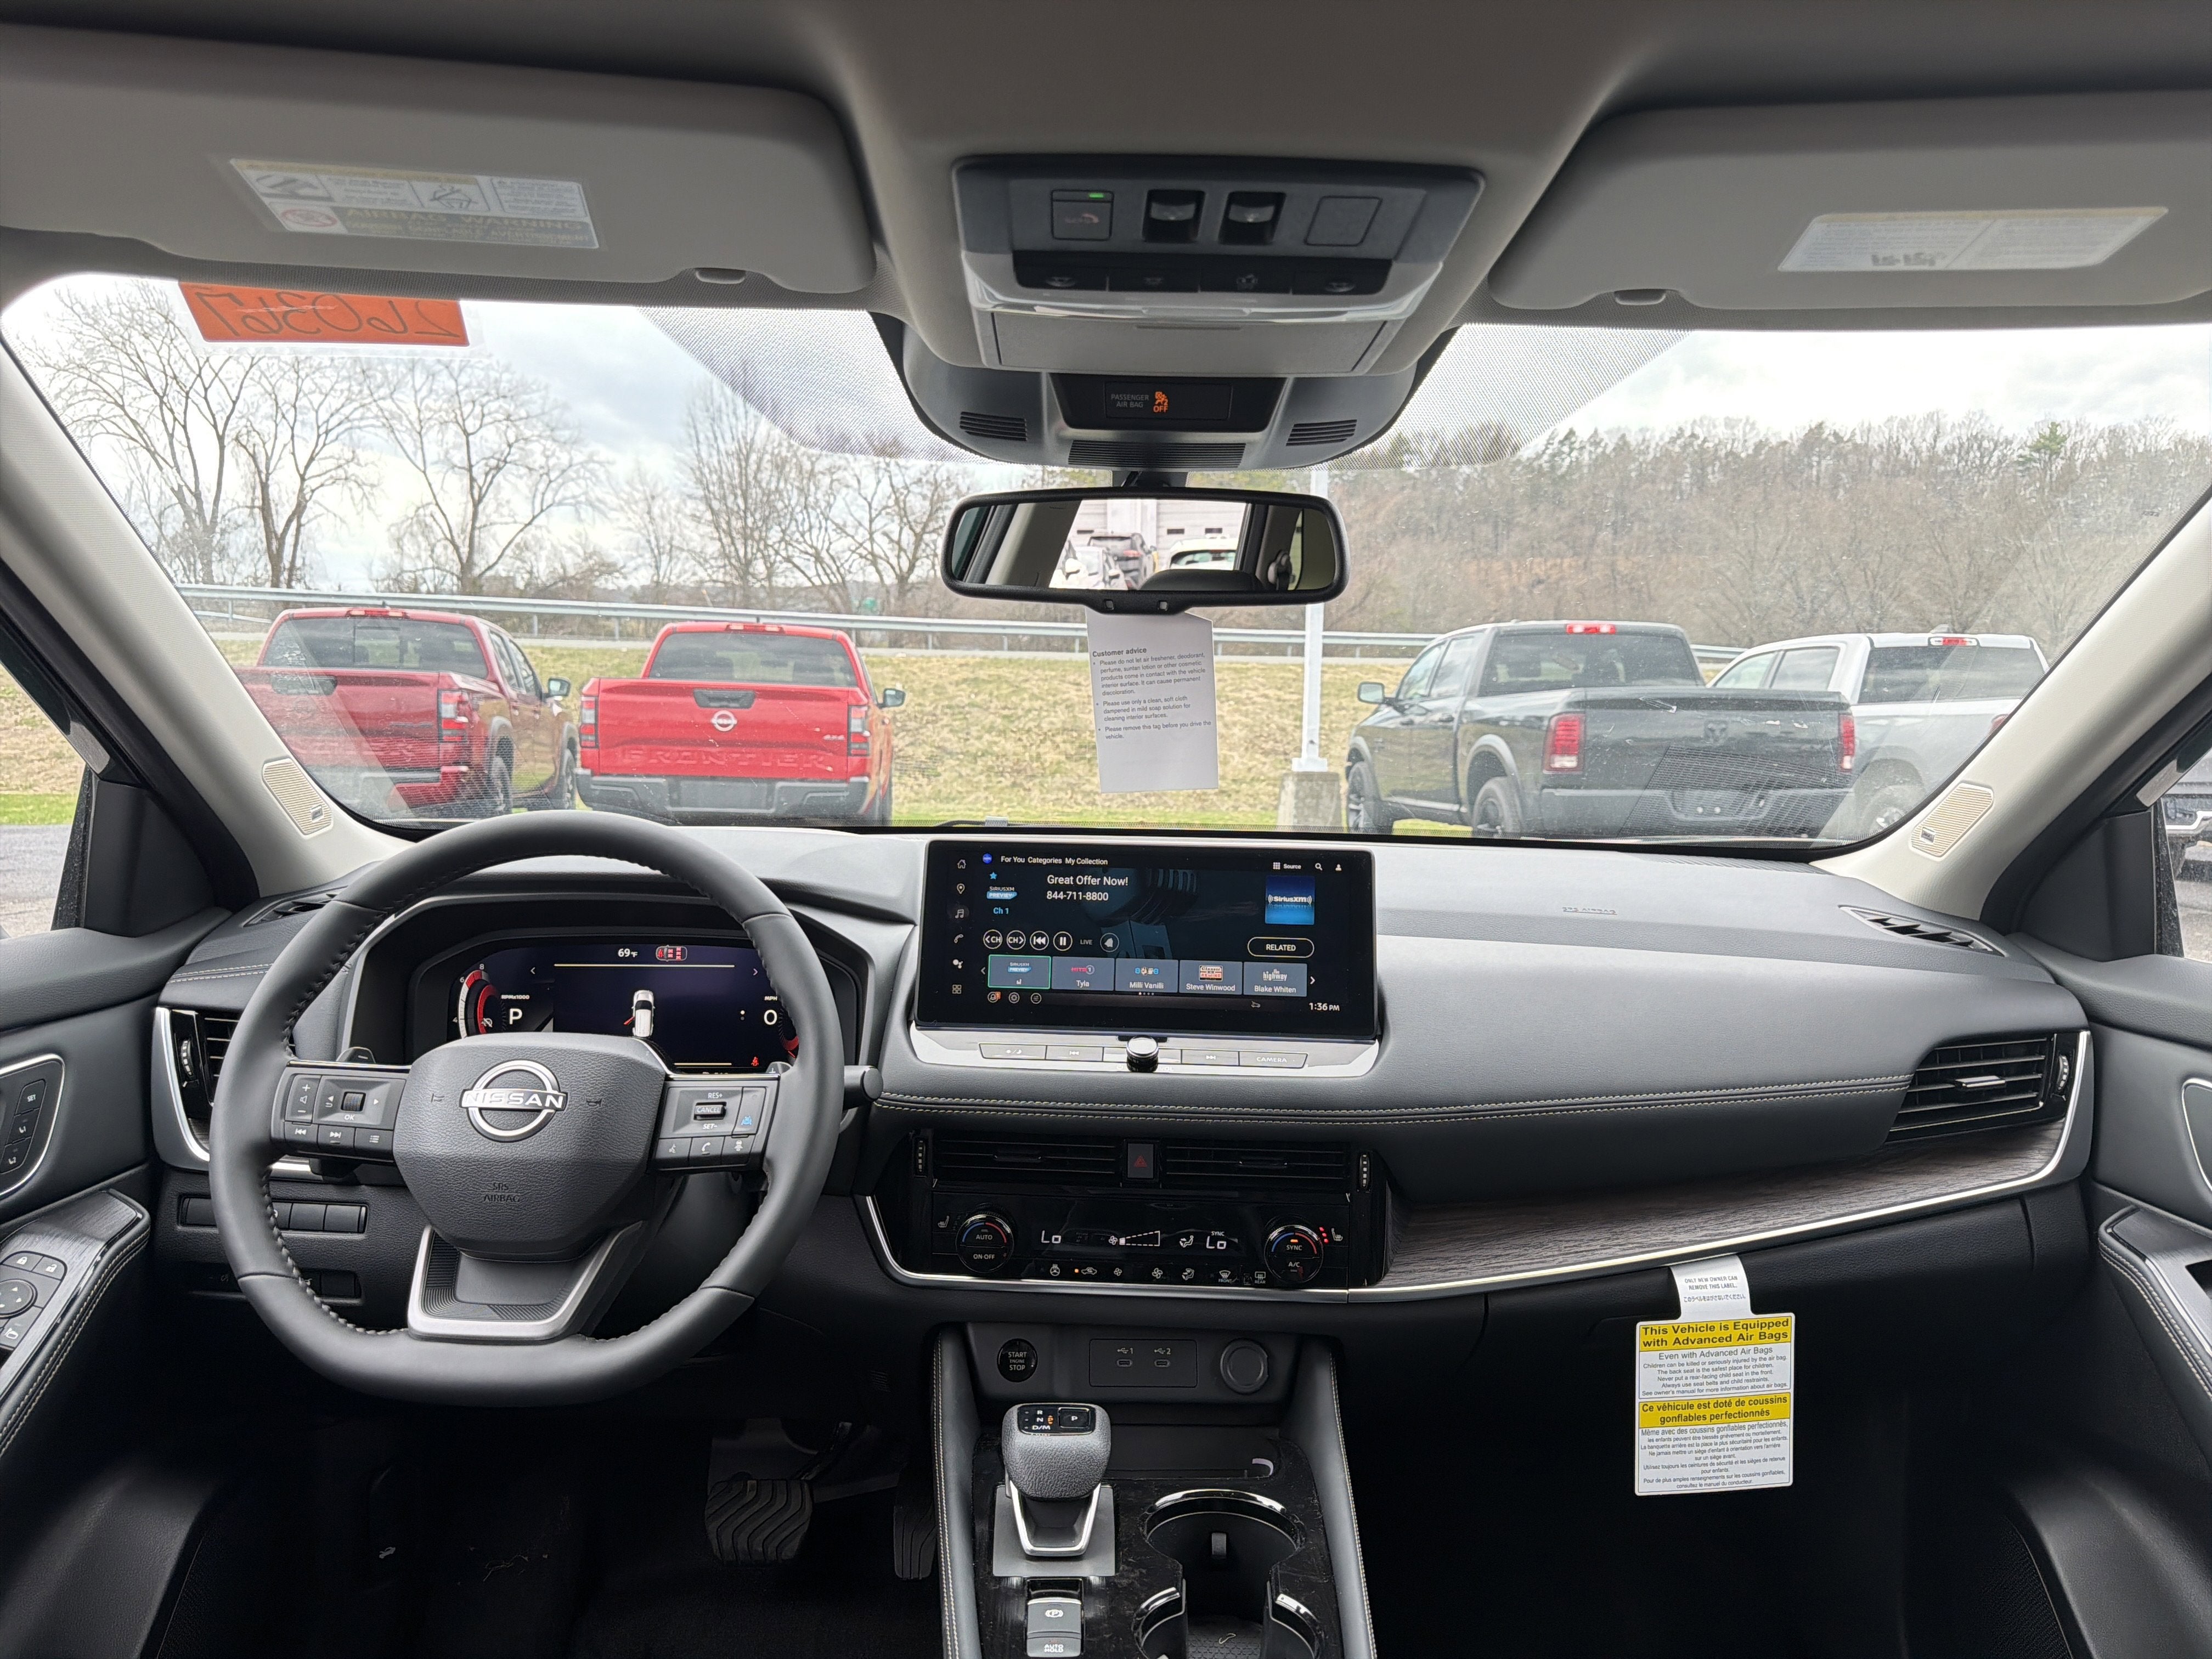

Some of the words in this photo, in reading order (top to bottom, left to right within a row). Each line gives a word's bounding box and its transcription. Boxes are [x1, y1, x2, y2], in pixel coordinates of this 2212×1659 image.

[1028, 857, 1062, 865] Categories
[1047, 875, 1074, 884] Great
[1076, 876, 1101, 885] Offer
[1103, 876, 1128, 886] Now!
[1046, 891, 1109, 901] 844-711-8800
[1263, 971, 1287, 980] highway
[1076, 980, 1090, 988] Tyla
[1309, 1002, 1328, 1011] 1:36
[509, 1008, 522, 1025] P
[27, 1094, 36, 1102] SET
[465, 1092, 564, 1109] NISSAN
[492, 1182, 510, 1191] SRS
[483, 1194, 521, 1203] AIRBAG
[1643, 1325, 1668, 1335] This
[1672, 1323, 1715, 1334] Vehicle
[1719, 1322, 1729, 1331] is
[1733, 1318, 1788, 1333] Equipped
[1643, 1338, 1667, 1347] with
[1672, 1333, 1732, 1345] Advanced
[1736, 1332, 1754, 1341] Air
[1758, 1330, 1788, 1342] Bags
[1699, 1348, 1737, 1357] Advanced
[1753, 1346, 1773, 1356] Bags
[1642, 1404, 1654, 1412] Ce
[1656, 1401, 1694, 1411] véhicule
[1697, 1401, 1711, 1409] est
[1713, 1398, 1732, 1408] doté
[1748, 1396, 1787, 1406] coussins
[1660, 1413, 1707, 1425] gonflables
[1709, 1408, 1770, 1422] perfectionnés
[1689, 1425, 1714, 1433] coussins
[1716, 1423, 1746, 1433] gonflables
[1747, 1420, 1788, 1431] perfectionnés,
